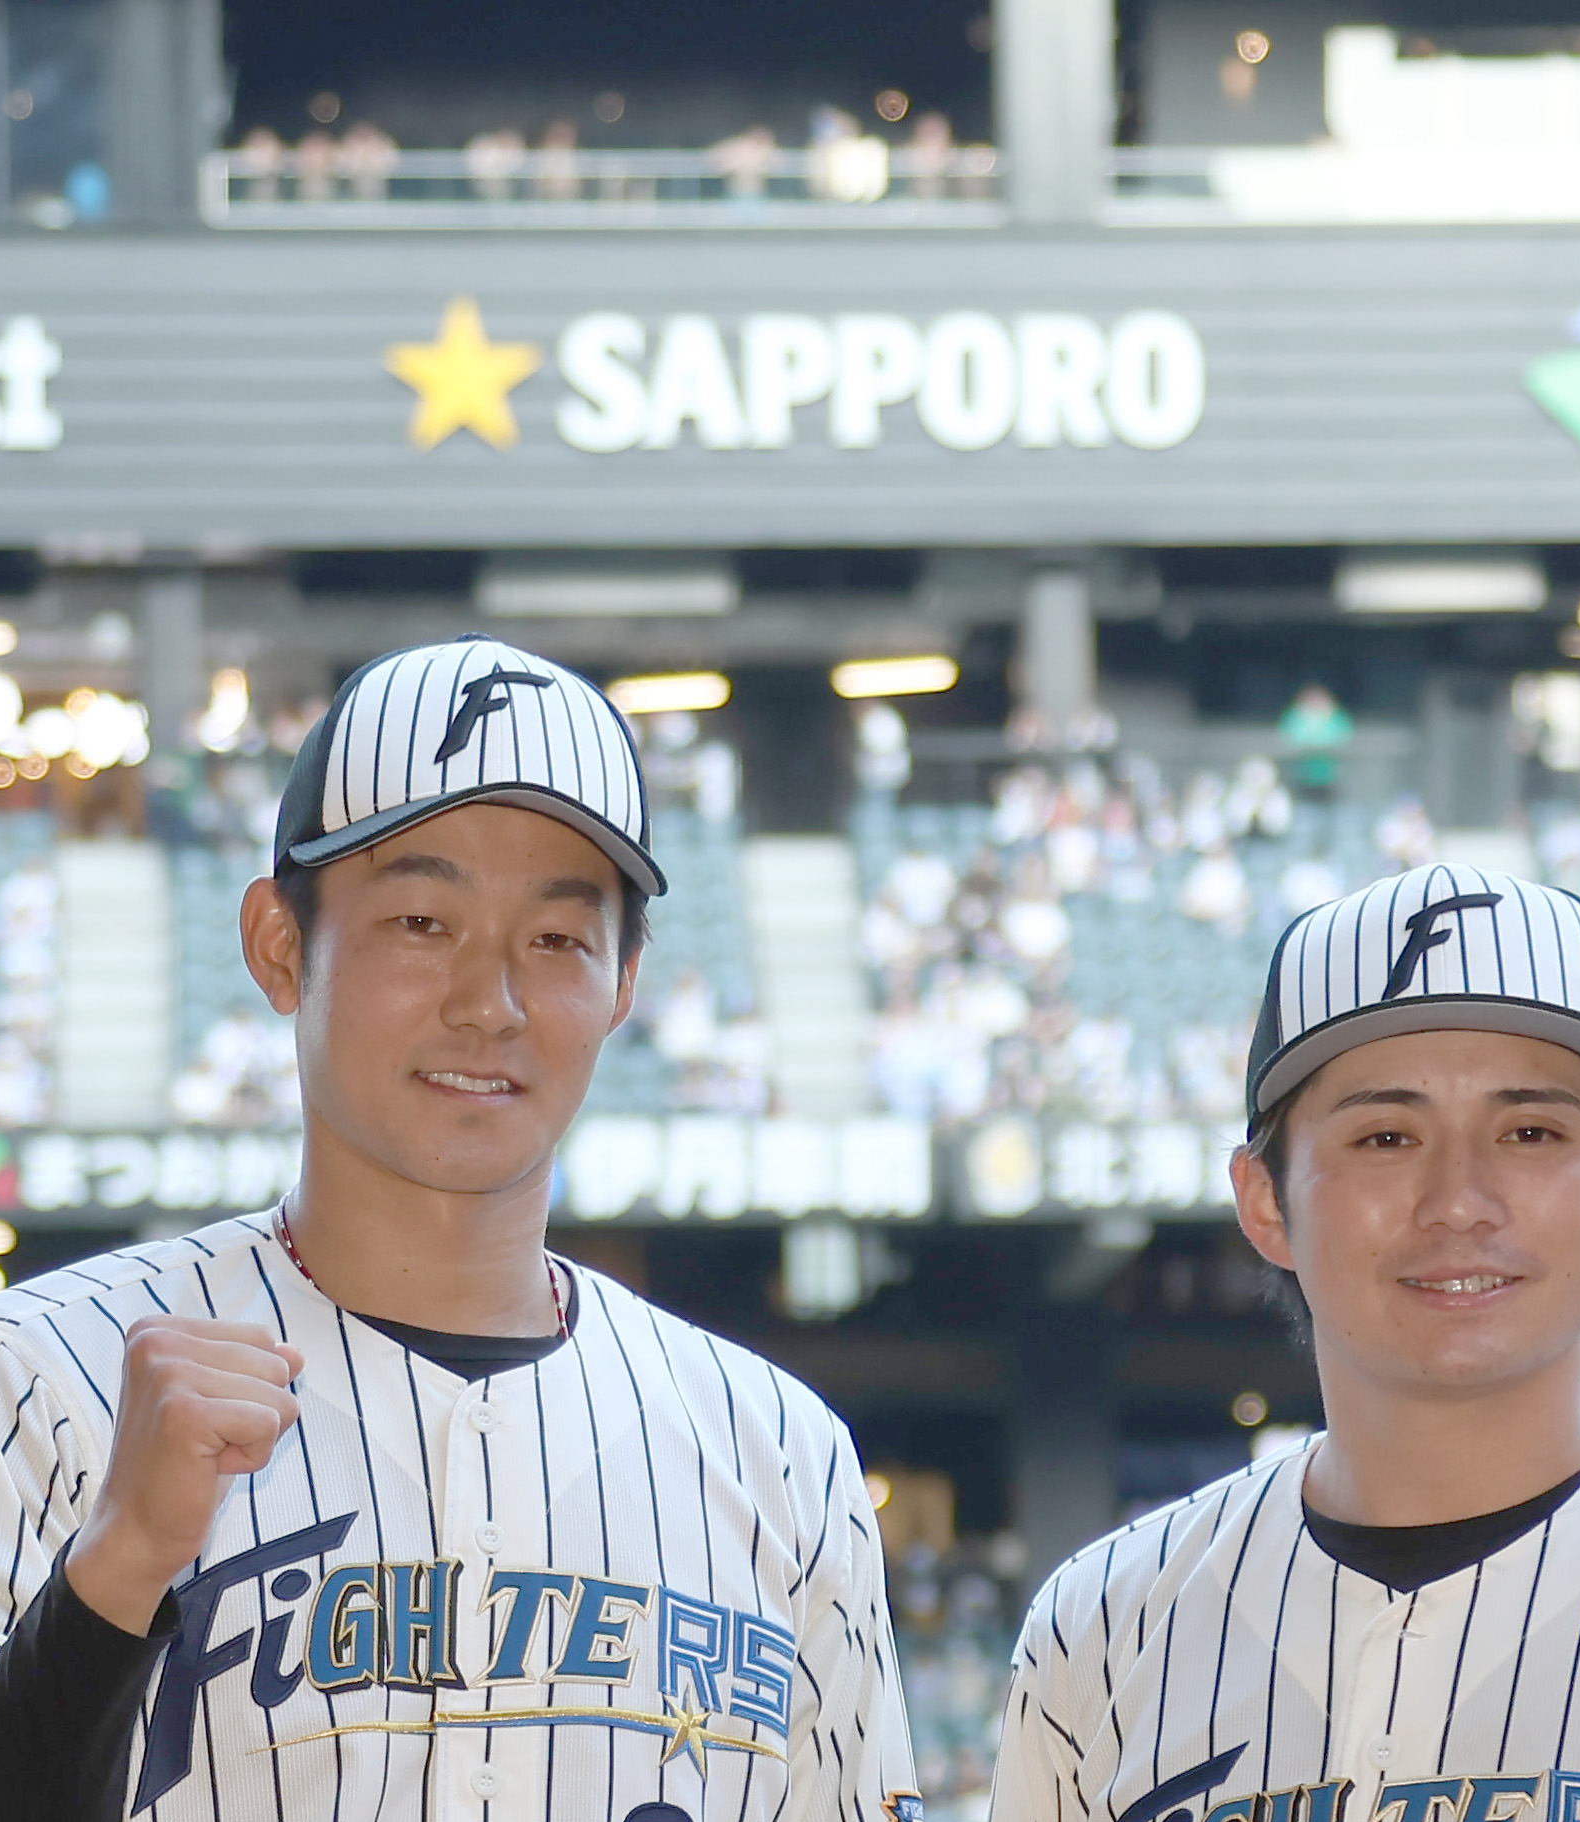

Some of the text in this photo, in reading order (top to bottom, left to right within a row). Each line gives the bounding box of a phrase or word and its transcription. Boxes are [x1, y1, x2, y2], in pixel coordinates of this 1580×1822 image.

[556, 310, 1206, 453] SAPPORO
[433, 669, 555, 765] F
[1382, 892, 1504, 1001] F
